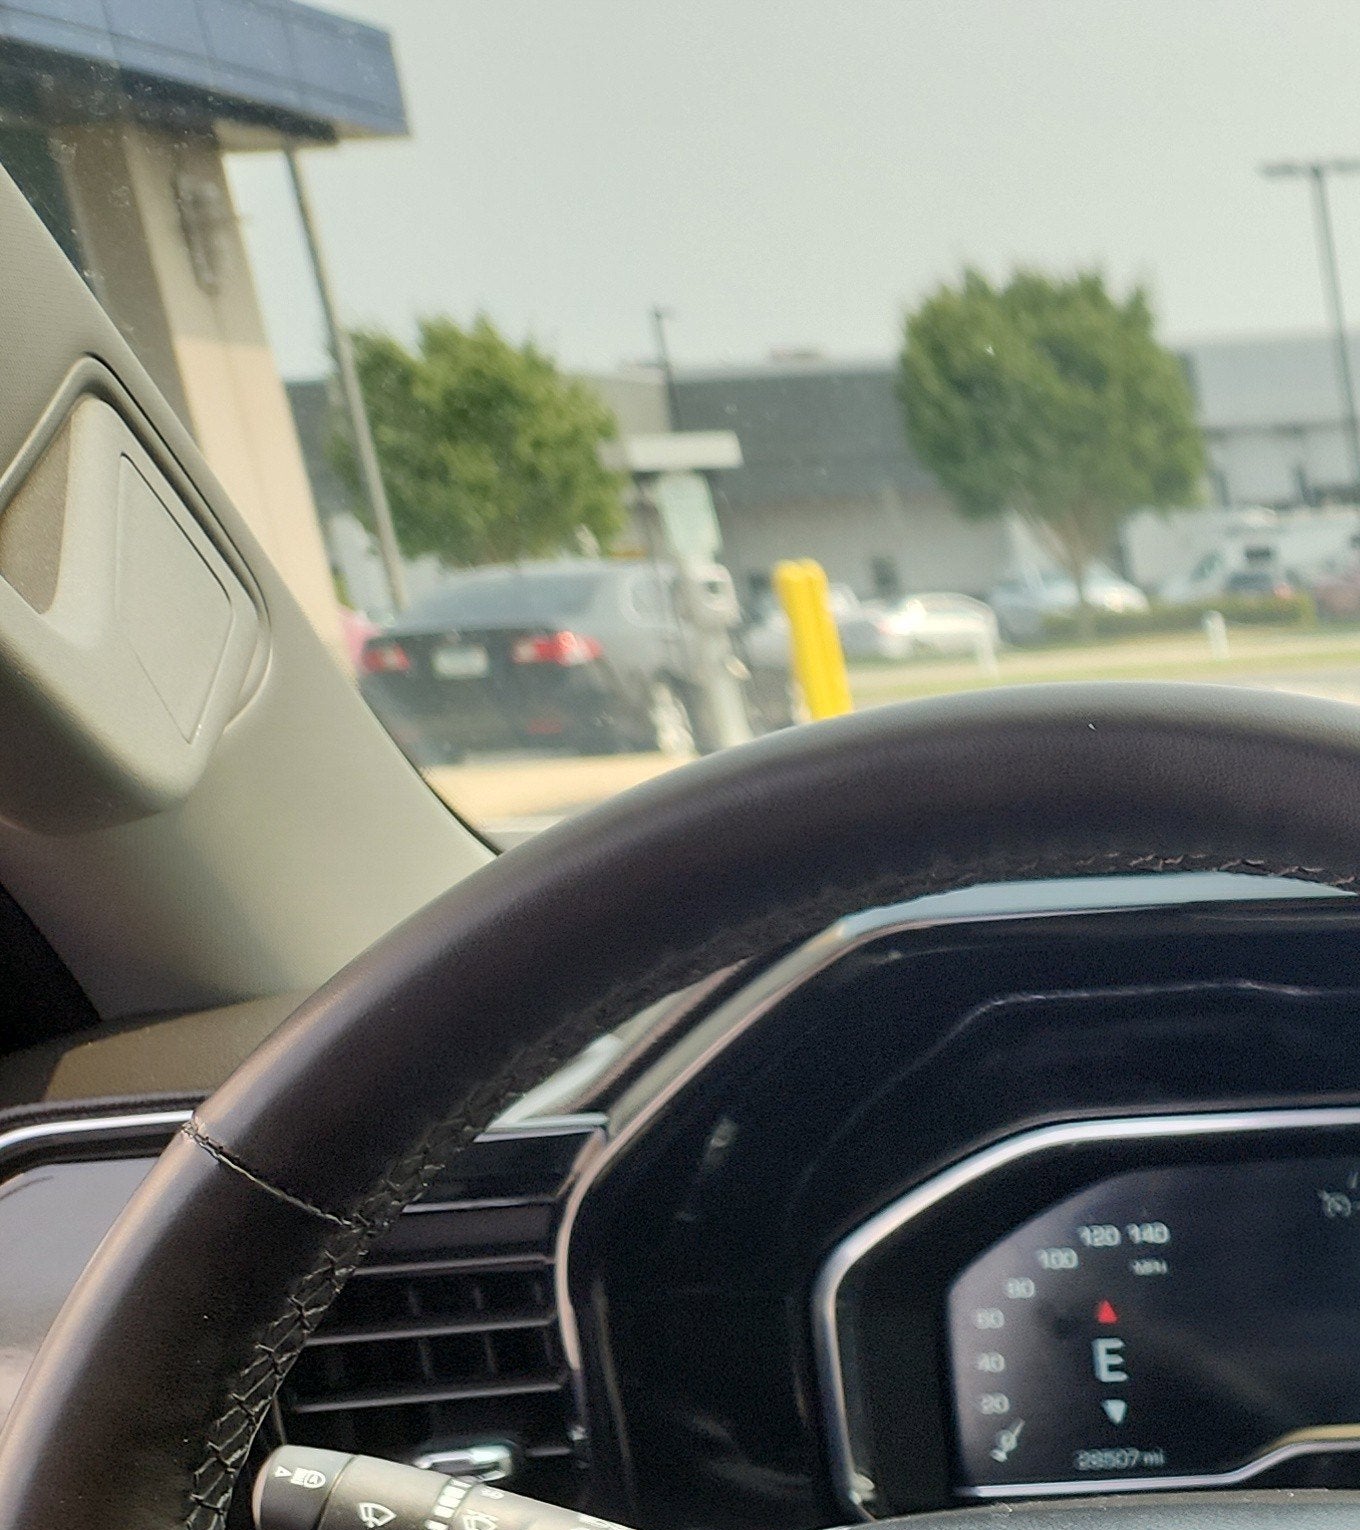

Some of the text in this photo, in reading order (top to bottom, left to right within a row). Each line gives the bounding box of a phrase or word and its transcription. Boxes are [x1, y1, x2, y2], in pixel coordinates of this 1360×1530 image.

[1077, 1225, 1121, 1246] 120
[1126, 1222, 1170, 1244] 140
[1038, 1248, 1078, 1269] 100
[974, 1352, 1006, 1373] 40
[1091, 1338, 1128, 1382] E
